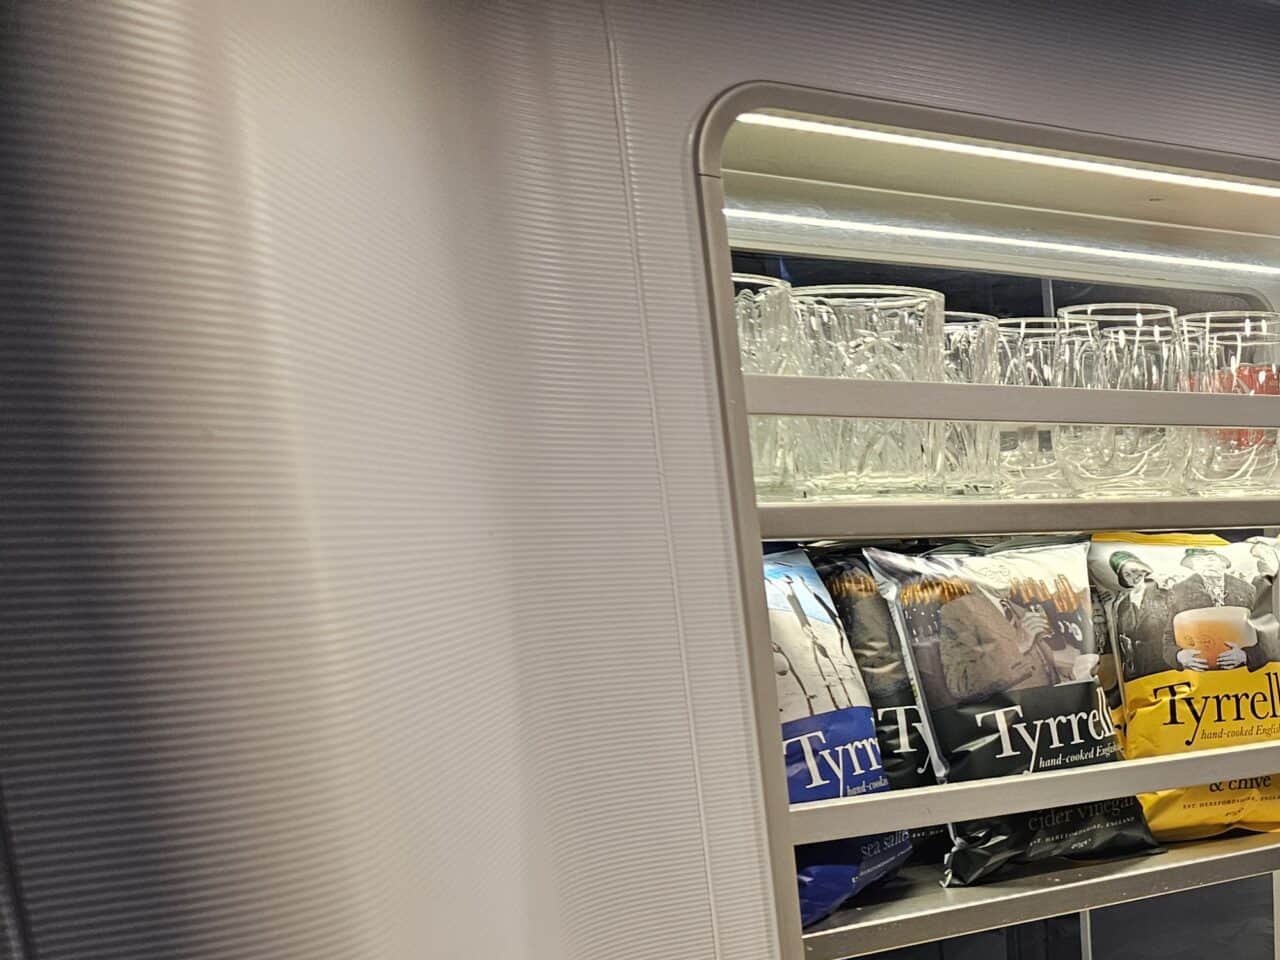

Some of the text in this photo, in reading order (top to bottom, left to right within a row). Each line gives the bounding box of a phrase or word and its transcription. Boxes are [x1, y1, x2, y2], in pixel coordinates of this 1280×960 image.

[1201, 726, 1254, 740] hand-cooked
[1039, 746, 1094, 769] hand-cooked
[1028, 808, 1074, 831] cider
[859, 842, 881, 857] sea
